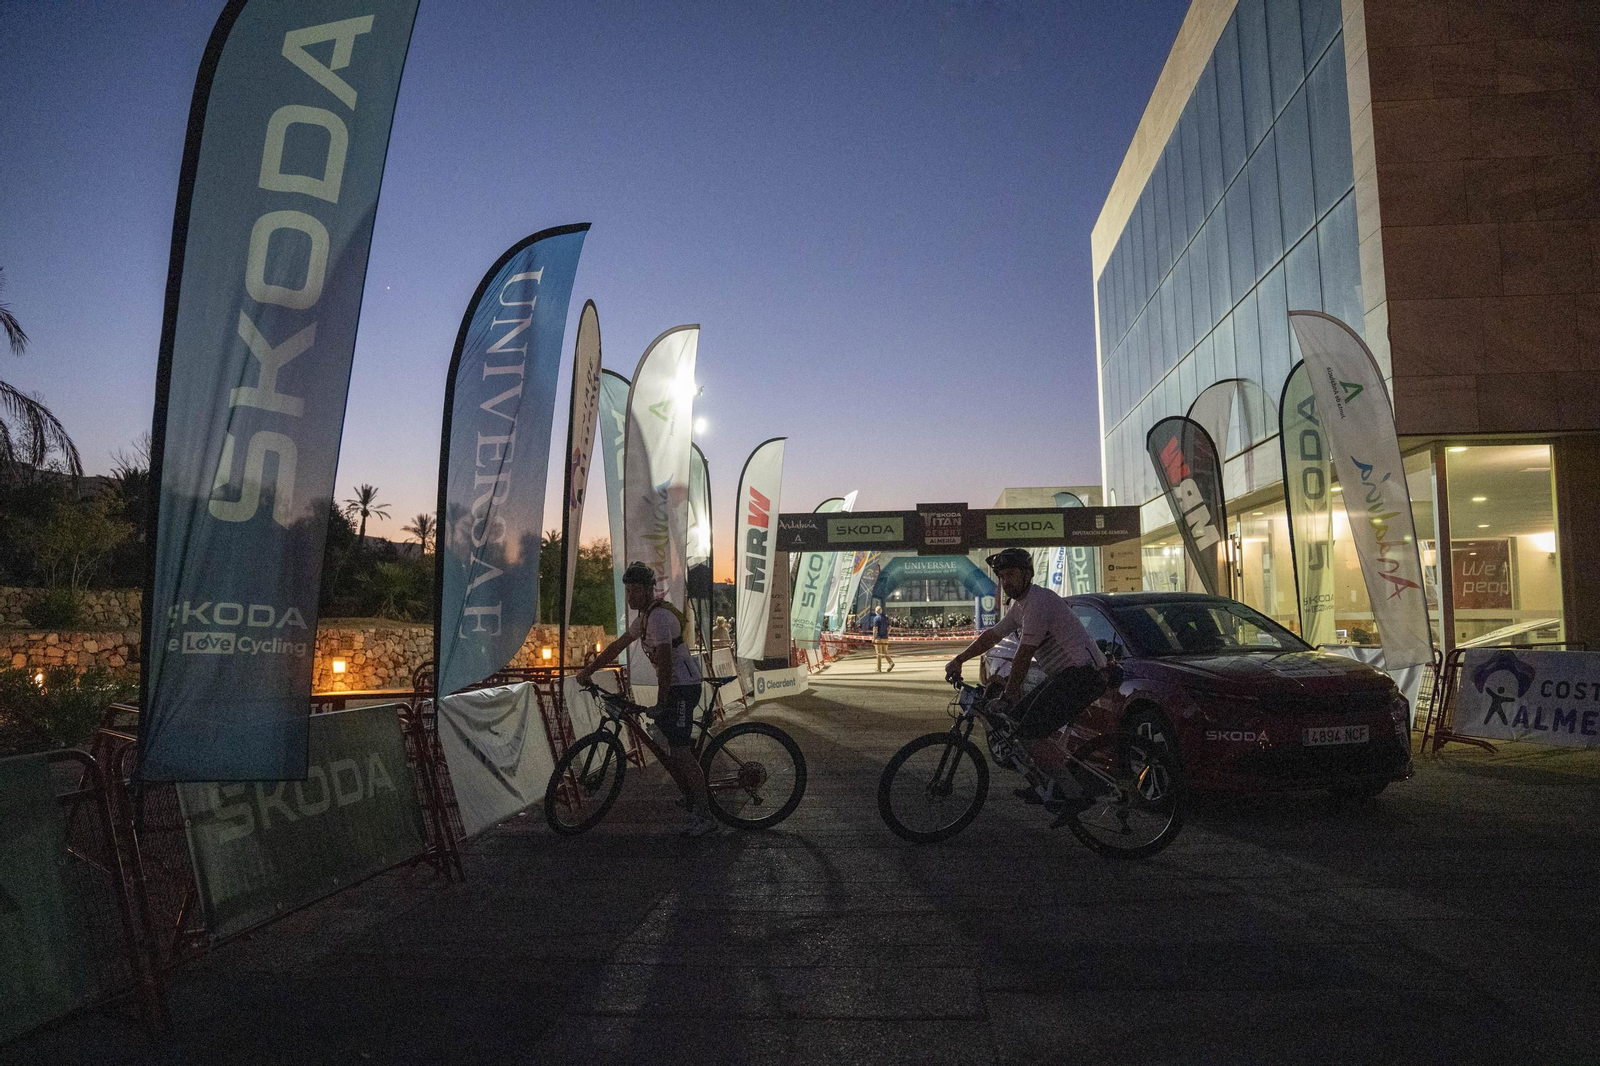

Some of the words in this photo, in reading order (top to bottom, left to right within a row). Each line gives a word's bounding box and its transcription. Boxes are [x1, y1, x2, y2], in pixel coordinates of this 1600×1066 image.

[459, 266, 545, 640] UNIVERSAE
[919, 513, 961, 527] TITAN
[995, 521, 1055, 532] SKODA
[836, 525, 895, 536] SKODA
[745, 486, 770, 593] MRW
[904, 561, 957, 570] UNIVERSAE
[1462, 561, 1496, 576] We
[237, 636, 307, 656] Cycling
[766, 677, 796, 690] Cleardent
[1512, 705, 1600, 735] ALME
[1206, 731, 1270, 742] SKODA
[1311, 730, 1341, 744] 4894
[1344, 728, 1367, 742] NCF
